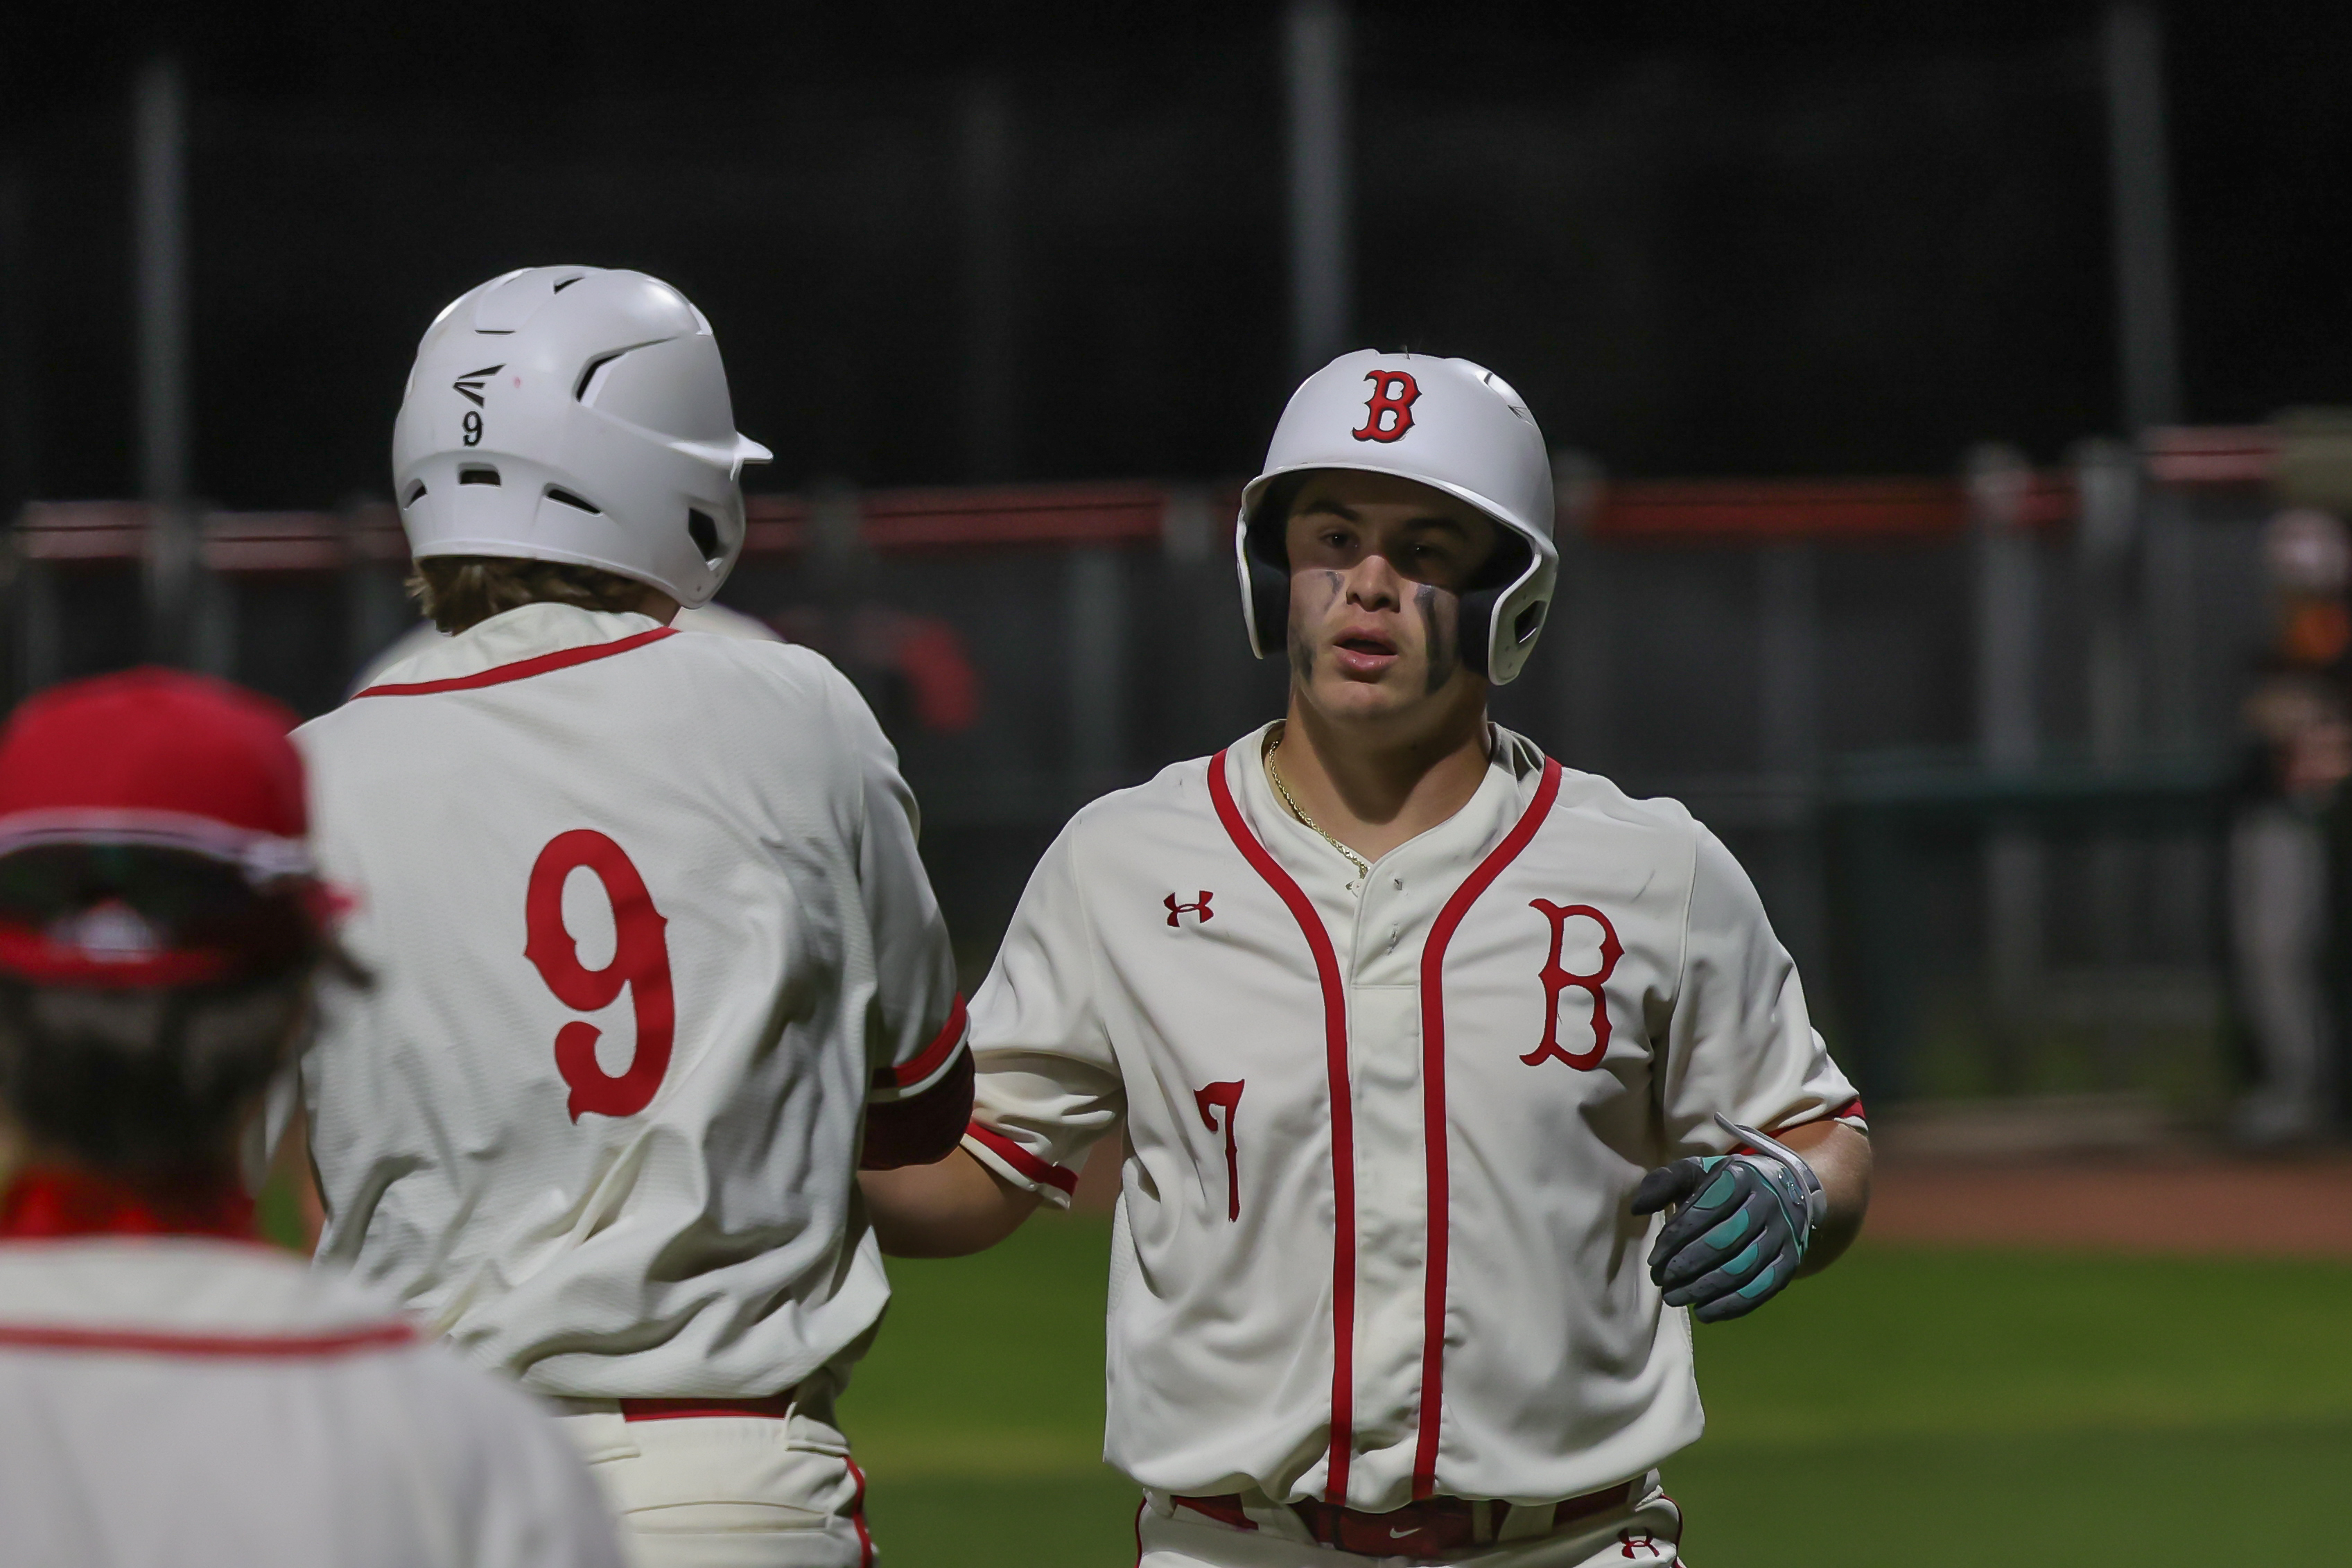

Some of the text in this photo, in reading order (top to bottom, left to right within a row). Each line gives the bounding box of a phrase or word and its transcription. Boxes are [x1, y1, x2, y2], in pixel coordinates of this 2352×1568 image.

[462, 411, 482, 446] 9
[1352, 369, 1423, 444] B
[523, 828, 675, 1126] 9
[1518, 898, 1626, 1072] B
[1193, 1079, 1246, 1223] 7
